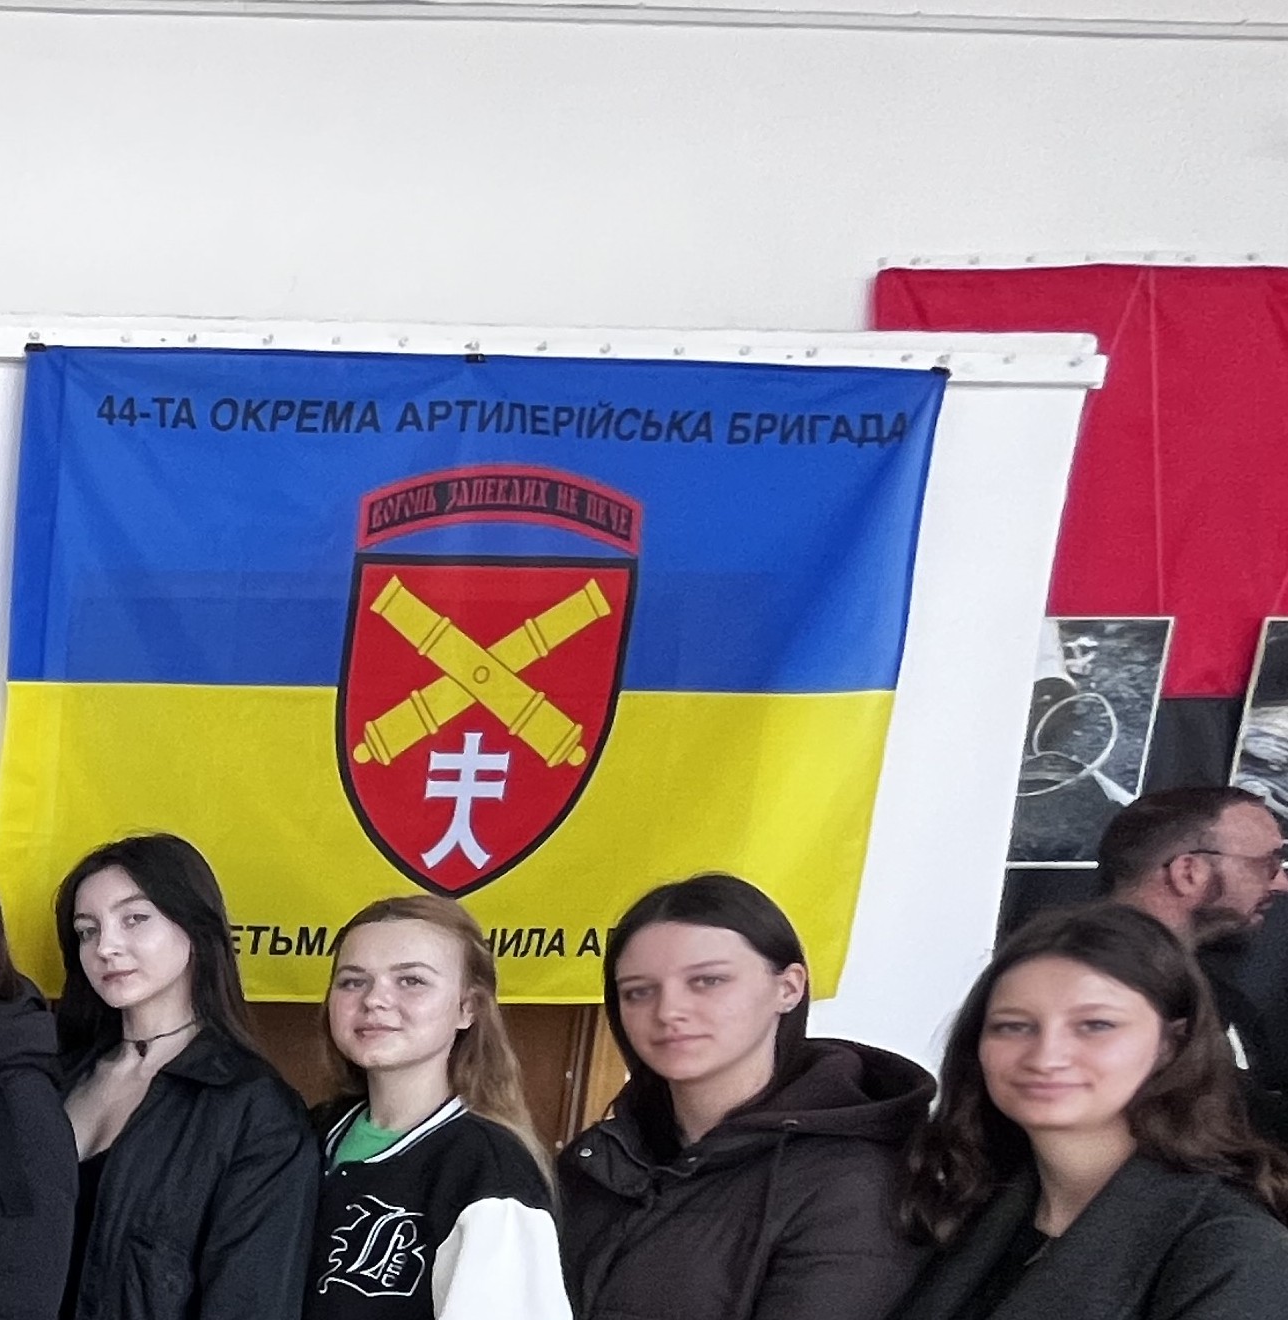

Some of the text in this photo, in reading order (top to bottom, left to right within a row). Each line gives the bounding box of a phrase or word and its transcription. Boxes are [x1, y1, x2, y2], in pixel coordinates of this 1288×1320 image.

[96, 395, 909, 449] 44-ТА ОКРЕМА АРТИЛЕРІЙСЬКА БРИГАДА
